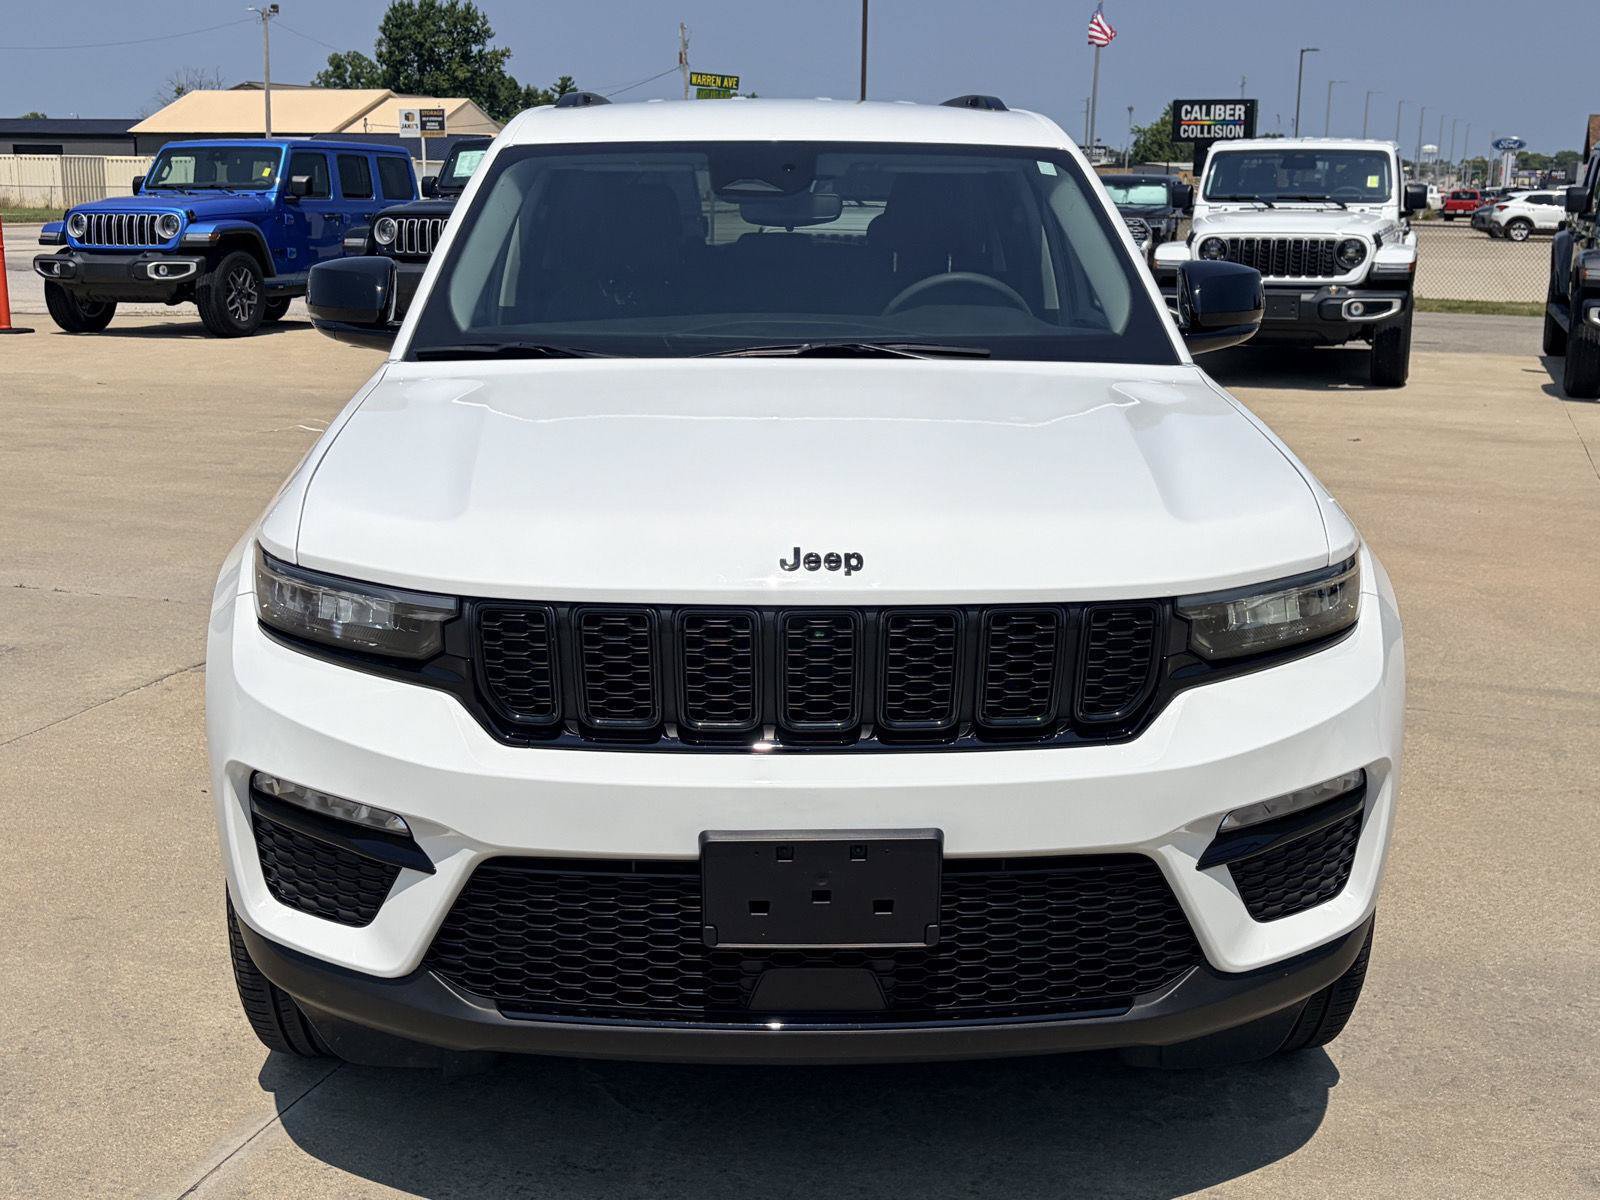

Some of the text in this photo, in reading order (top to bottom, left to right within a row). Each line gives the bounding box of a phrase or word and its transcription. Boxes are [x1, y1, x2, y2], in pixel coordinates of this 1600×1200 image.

[691, 73, 738, 88] WARREN AVE
[1181, 104, 1246, 121] CALIBER
[1180, 125, 1244, 138] COLLISION
[779, 547, 864, 576] Jeep
